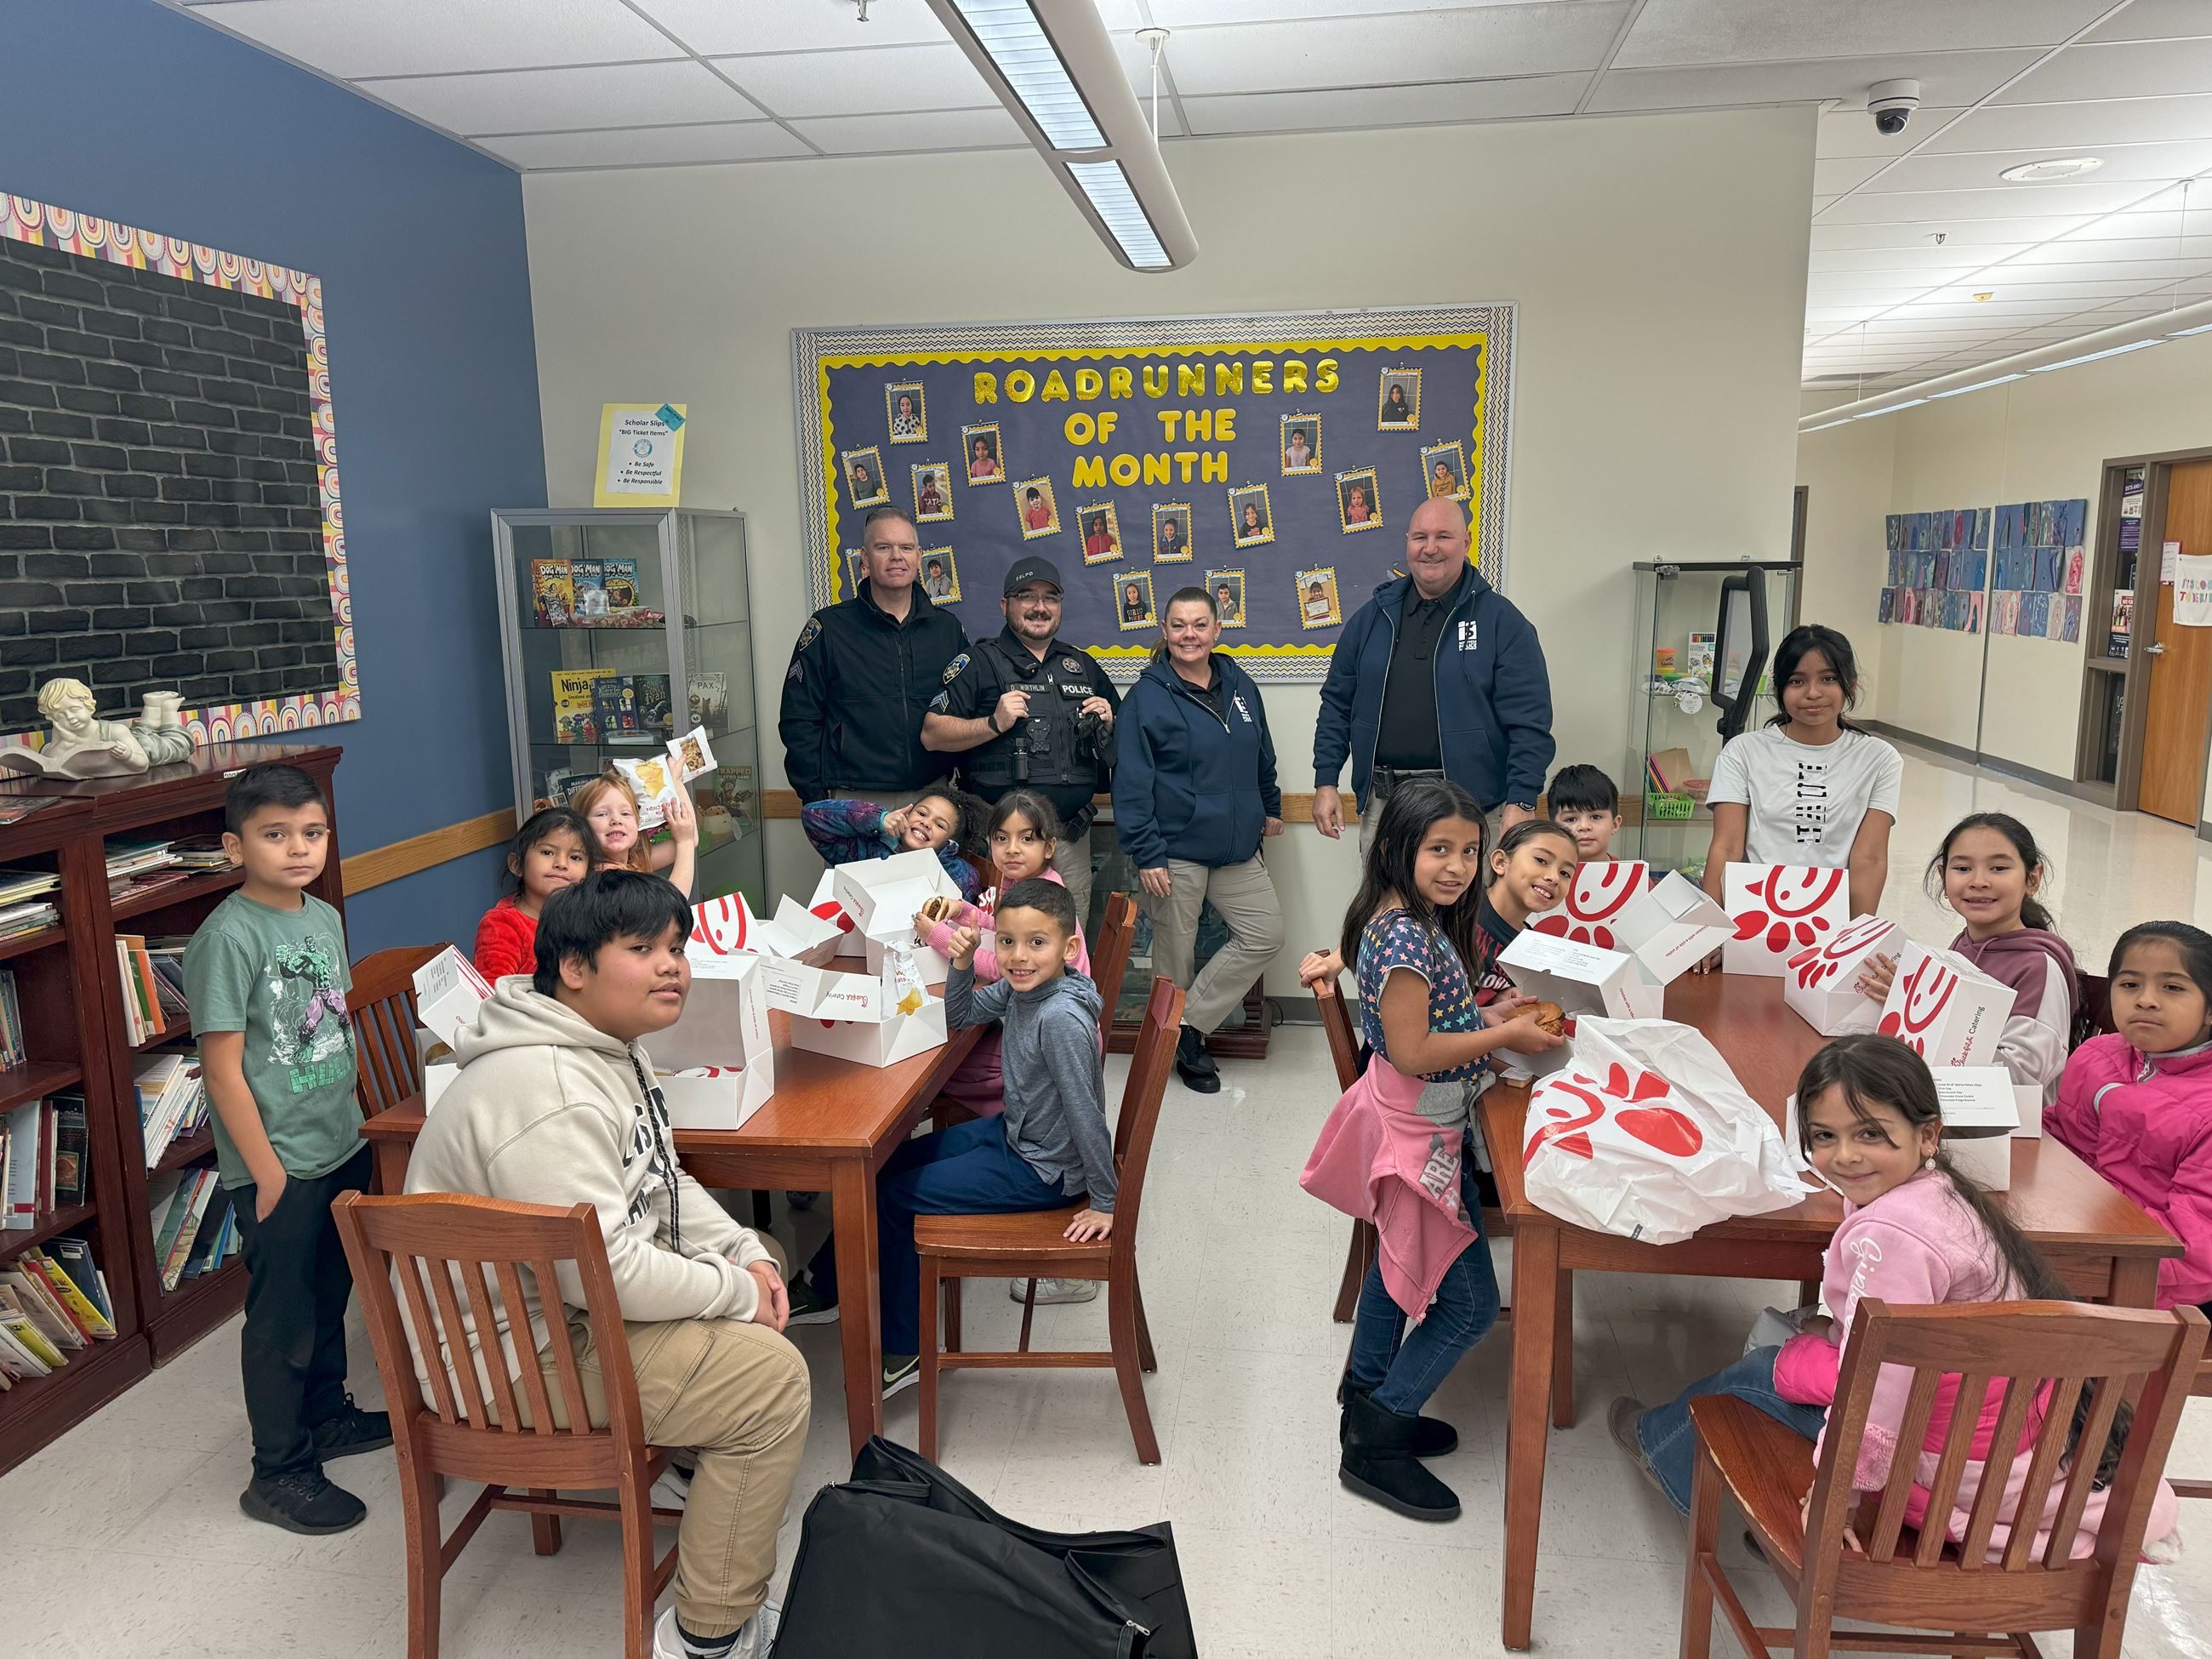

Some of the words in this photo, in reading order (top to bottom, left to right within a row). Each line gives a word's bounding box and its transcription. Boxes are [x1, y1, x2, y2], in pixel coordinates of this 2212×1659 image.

[972, 358, 1340, 405] ROADRUNNERS
[1063, 411, 1119, 446] OF
[1157, 408, 1237, 442] THE
[1072, 450, 1229, 488] MONTH
[539, 564, 553, 575] DOG
[555, 564, 568, 574] MAN
[584, 564, 601, 573] MAN
[617, 563, 633, 573] MAN
[562, 678, 589, 694] Ninja
[1061, 684, 1095, 696] POLICE
[1968, 1006, 1986, 1035] Catering
